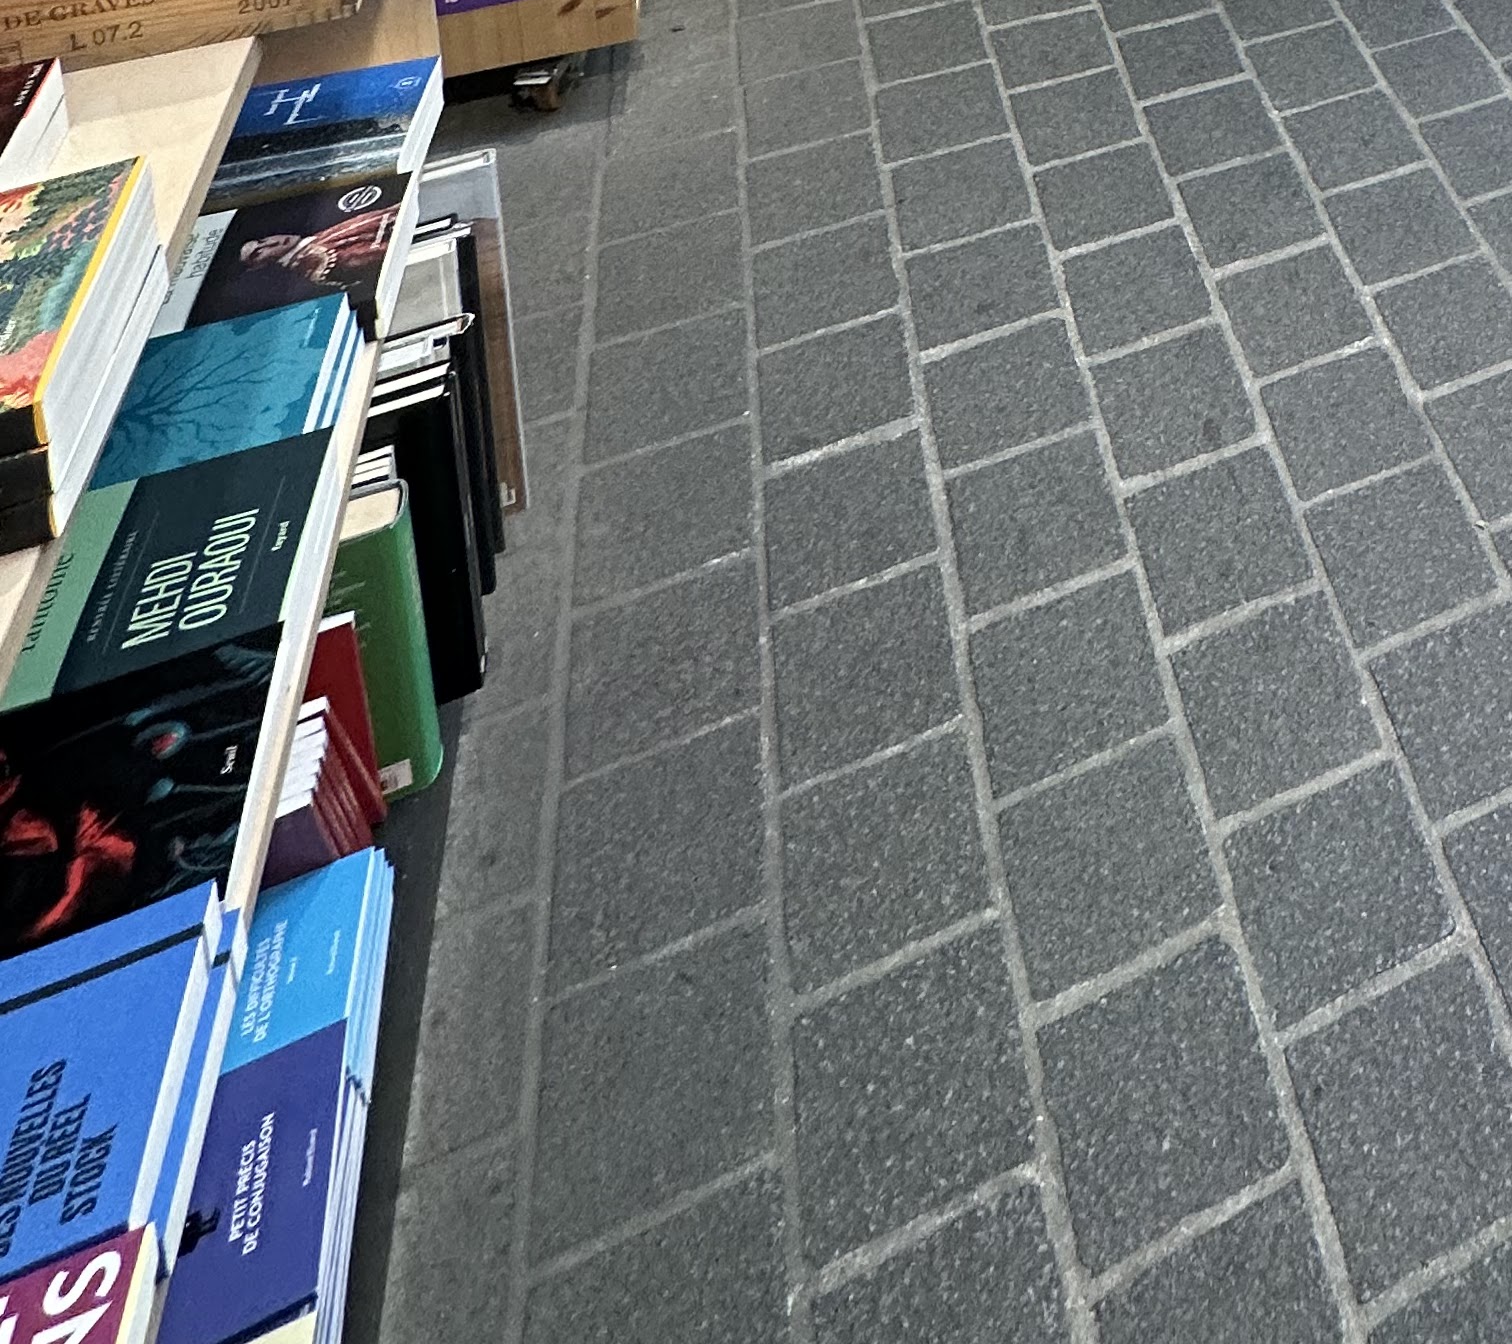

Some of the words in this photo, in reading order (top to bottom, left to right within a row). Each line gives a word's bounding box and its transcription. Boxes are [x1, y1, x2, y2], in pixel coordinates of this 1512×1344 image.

[3, 10, 41, 31] DE
[178, 508, 260, 631] OURAOUI
[120, 550, 198, 650] MEHDI
[240, 1011, 256, 1037] LES
[253, 1021, 270, 1043] DE
[59, 1122, 118, 1226] STOCK
[247, 1112, 275, 1229] CONJUGAISON
[228, 1196, 249, 1243] PETIT
[241, 1228, 261, 1257] DE
